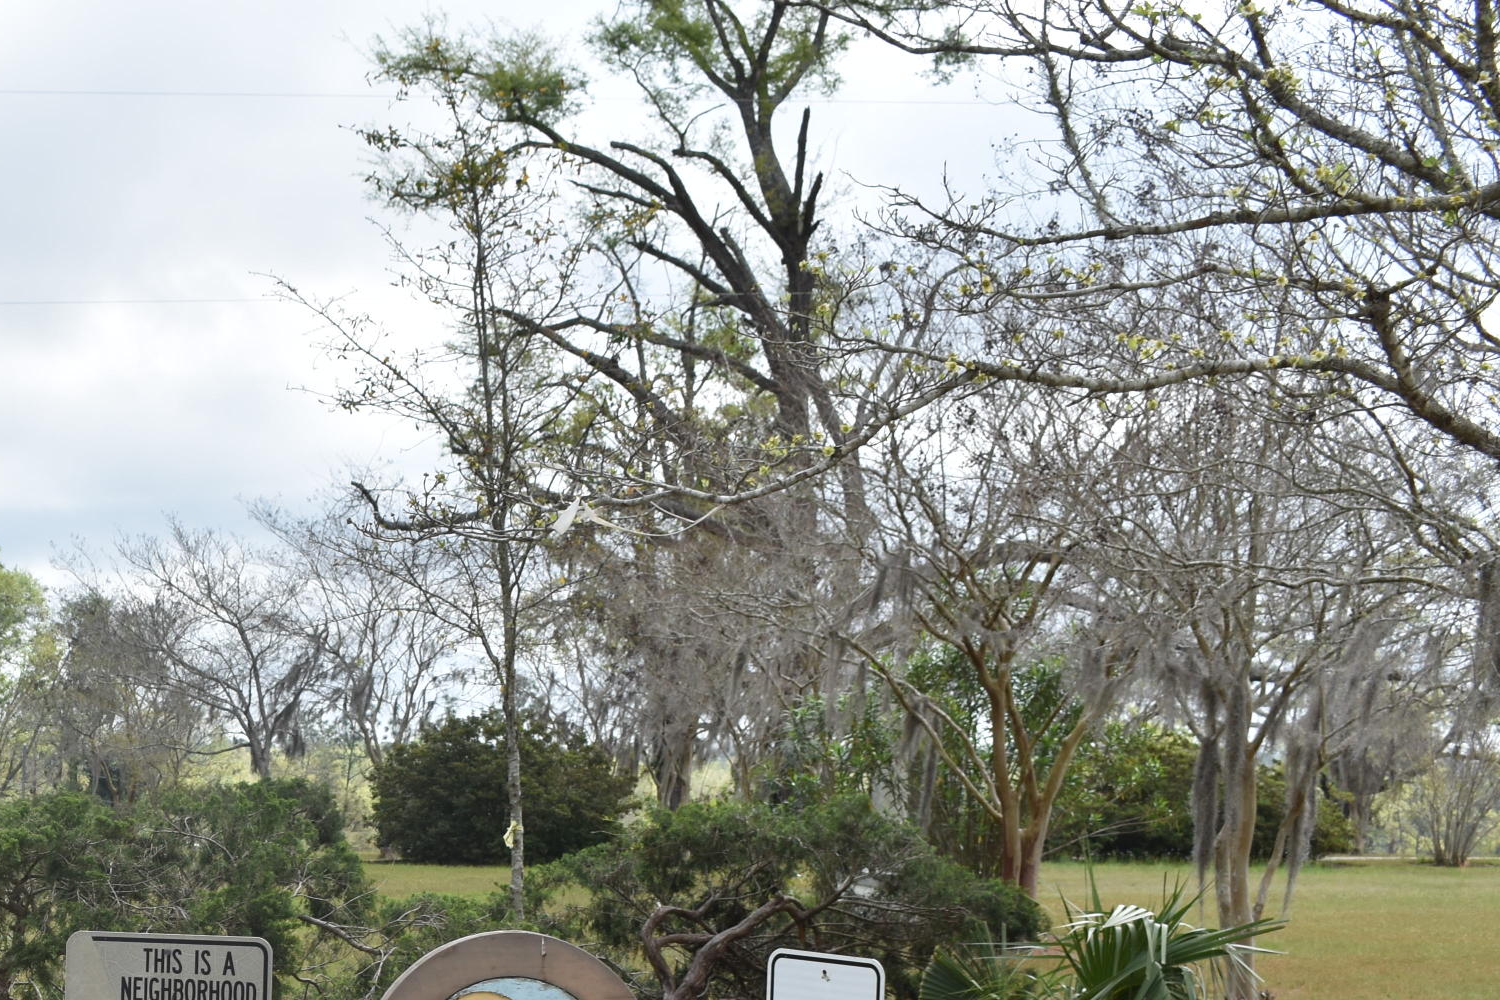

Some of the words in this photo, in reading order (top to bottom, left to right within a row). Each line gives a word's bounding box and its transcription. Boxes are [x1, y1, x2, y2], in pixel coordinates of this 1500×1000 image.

[143, 948, 183, 974] THIS
[194, 950, 211, 976] IS
[222, 951, 236, 977] A
